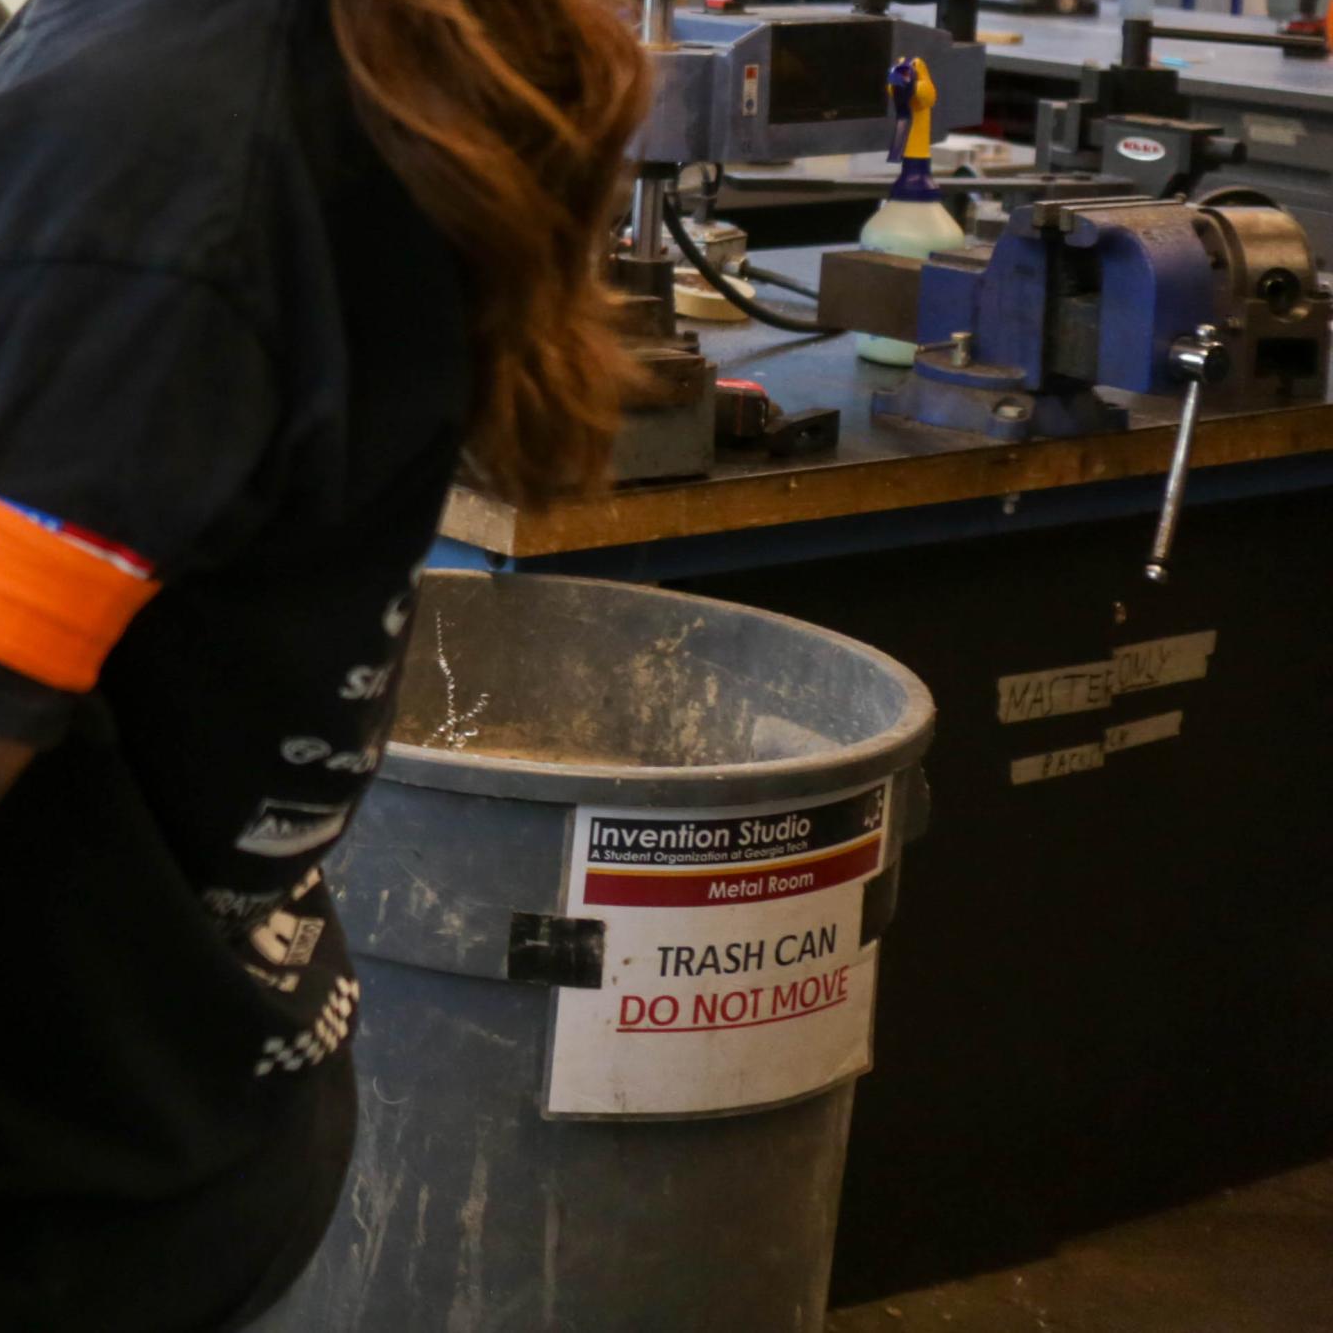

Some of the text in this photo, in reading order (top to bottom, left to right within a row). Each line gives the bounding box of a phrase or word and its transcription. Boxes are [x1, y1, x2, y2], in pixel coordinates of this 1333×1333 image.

[592, 814, 811, 848] Invention Studio
[591, 840, 809, 865] A Student Organization at Georgia Tech
[708, 872, 814, 900] Metal Room
[657, 923, 837, 978] TRASH CAN
[618, 965, 850, 1027] DO NOT MOVE
